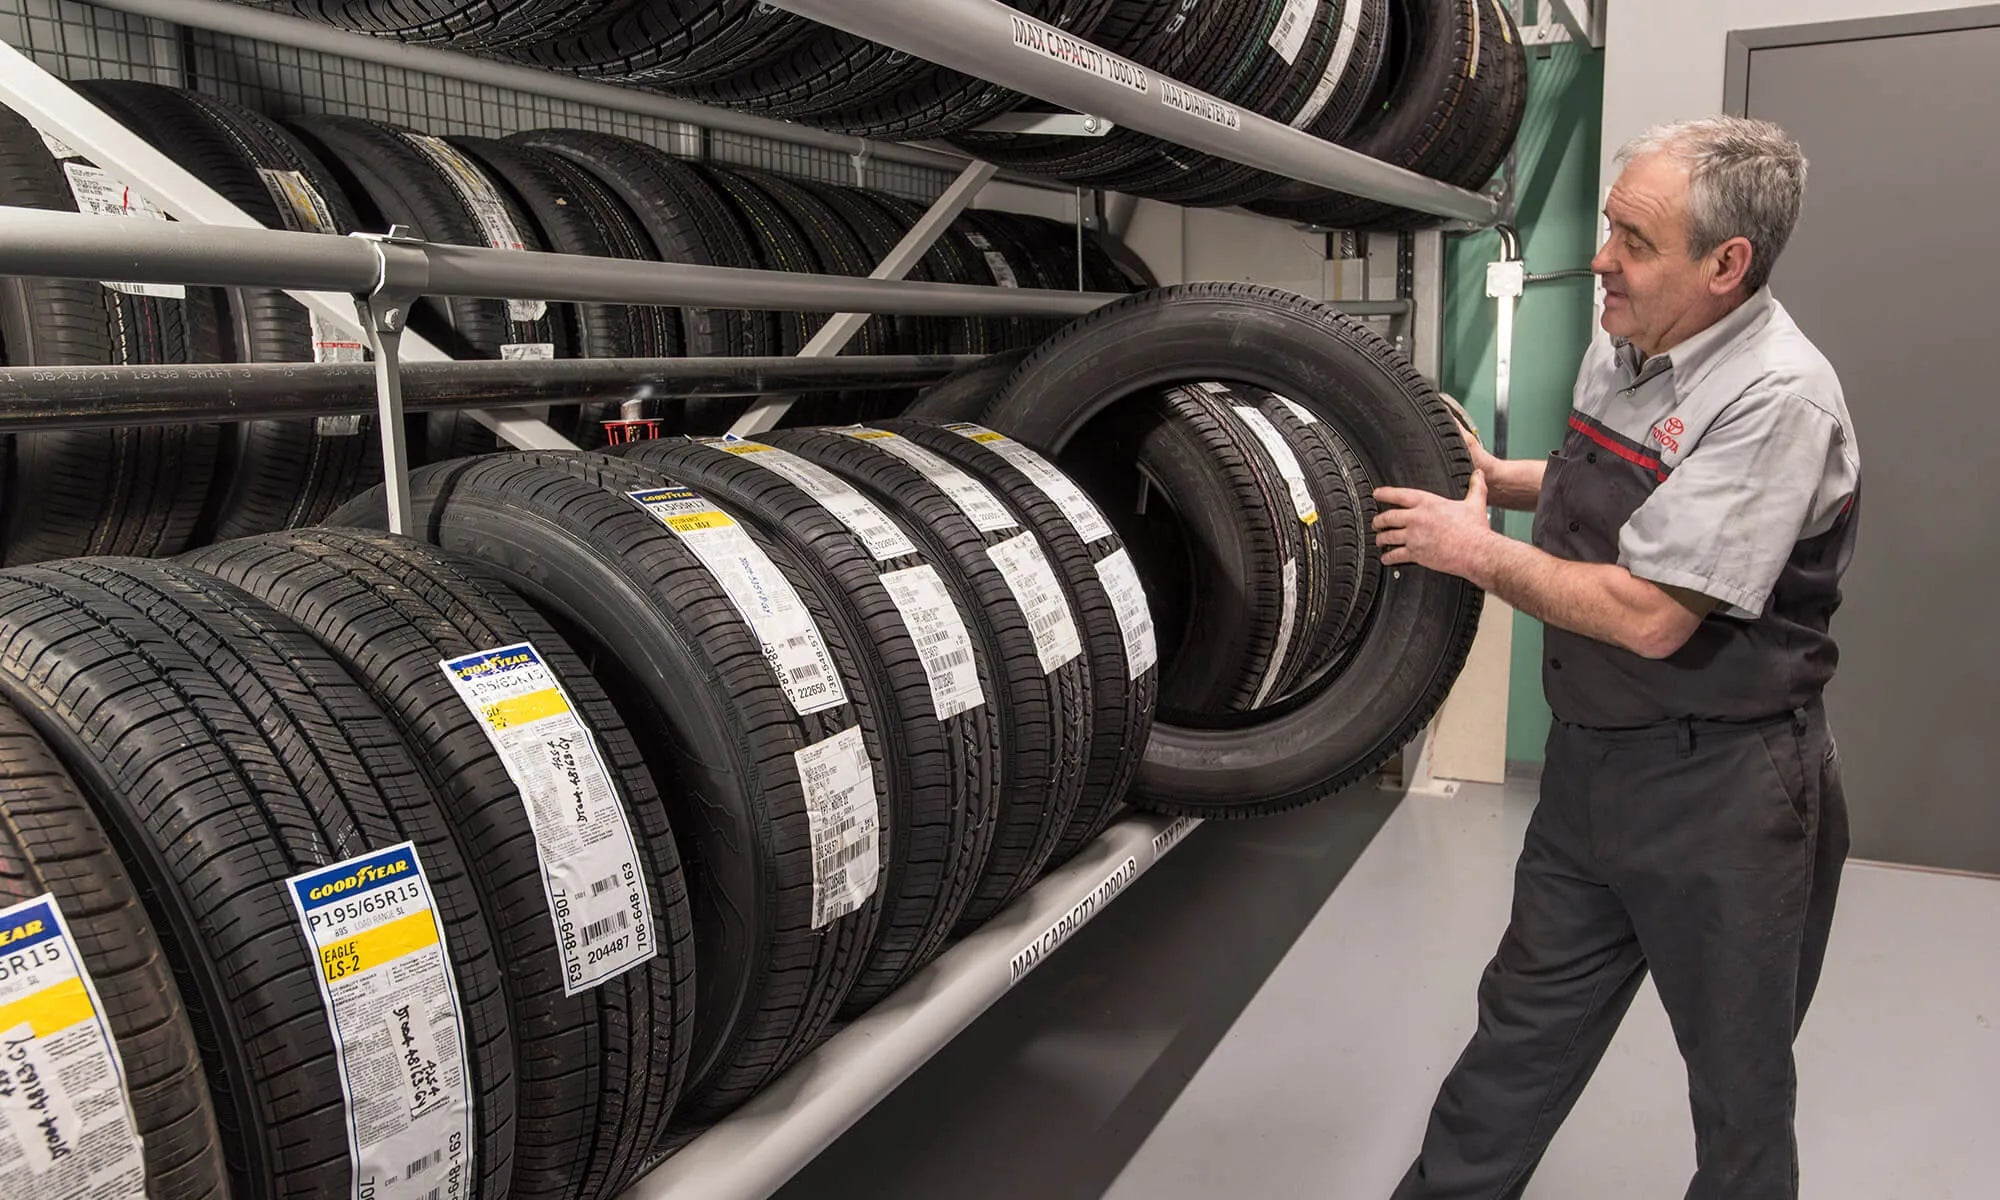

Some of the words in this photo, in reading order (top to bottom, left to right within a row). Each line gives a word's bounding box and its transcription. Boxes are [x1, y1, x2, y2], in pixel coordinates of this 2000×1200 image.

[1014, 17, 1046, 53] MAX
[1049, 32, 1103, 75] CAPACITY
[1106, 57, 1133, 85] 1000
[1134, 66, 1147, 91] LB
[1161, 82, 1183, 107] MAX
[1184, 91, 1226, 126] DIAMETER
[187, 368, 232, 379] SHIFT
[1652, 426, 1679, 454] TOYOTA
[798, 682, 827, 699] 222650
[309, 860, 408, 900] GOODYEAR
[309, 882, 419, 932] P195/65R15
[622, 862, 647, 951] 706-648-163
[1012, 941, 1040, 980] MAX
[1043, 893, 1096, 954] CAPACITY
[1098, 871, 1122, 904] 1000
[1123, 859, 1135, 882] LB
[324, 941, 357, 963] EAGLE
[554, 889, 582, 982] 706-648-163
[588, 935, 629, 964] 204487
[328, 955, 360, 981] LS-2
[447, 1131, 461, 1200] -648-163
[360, 1176, 375, 1200] 70
